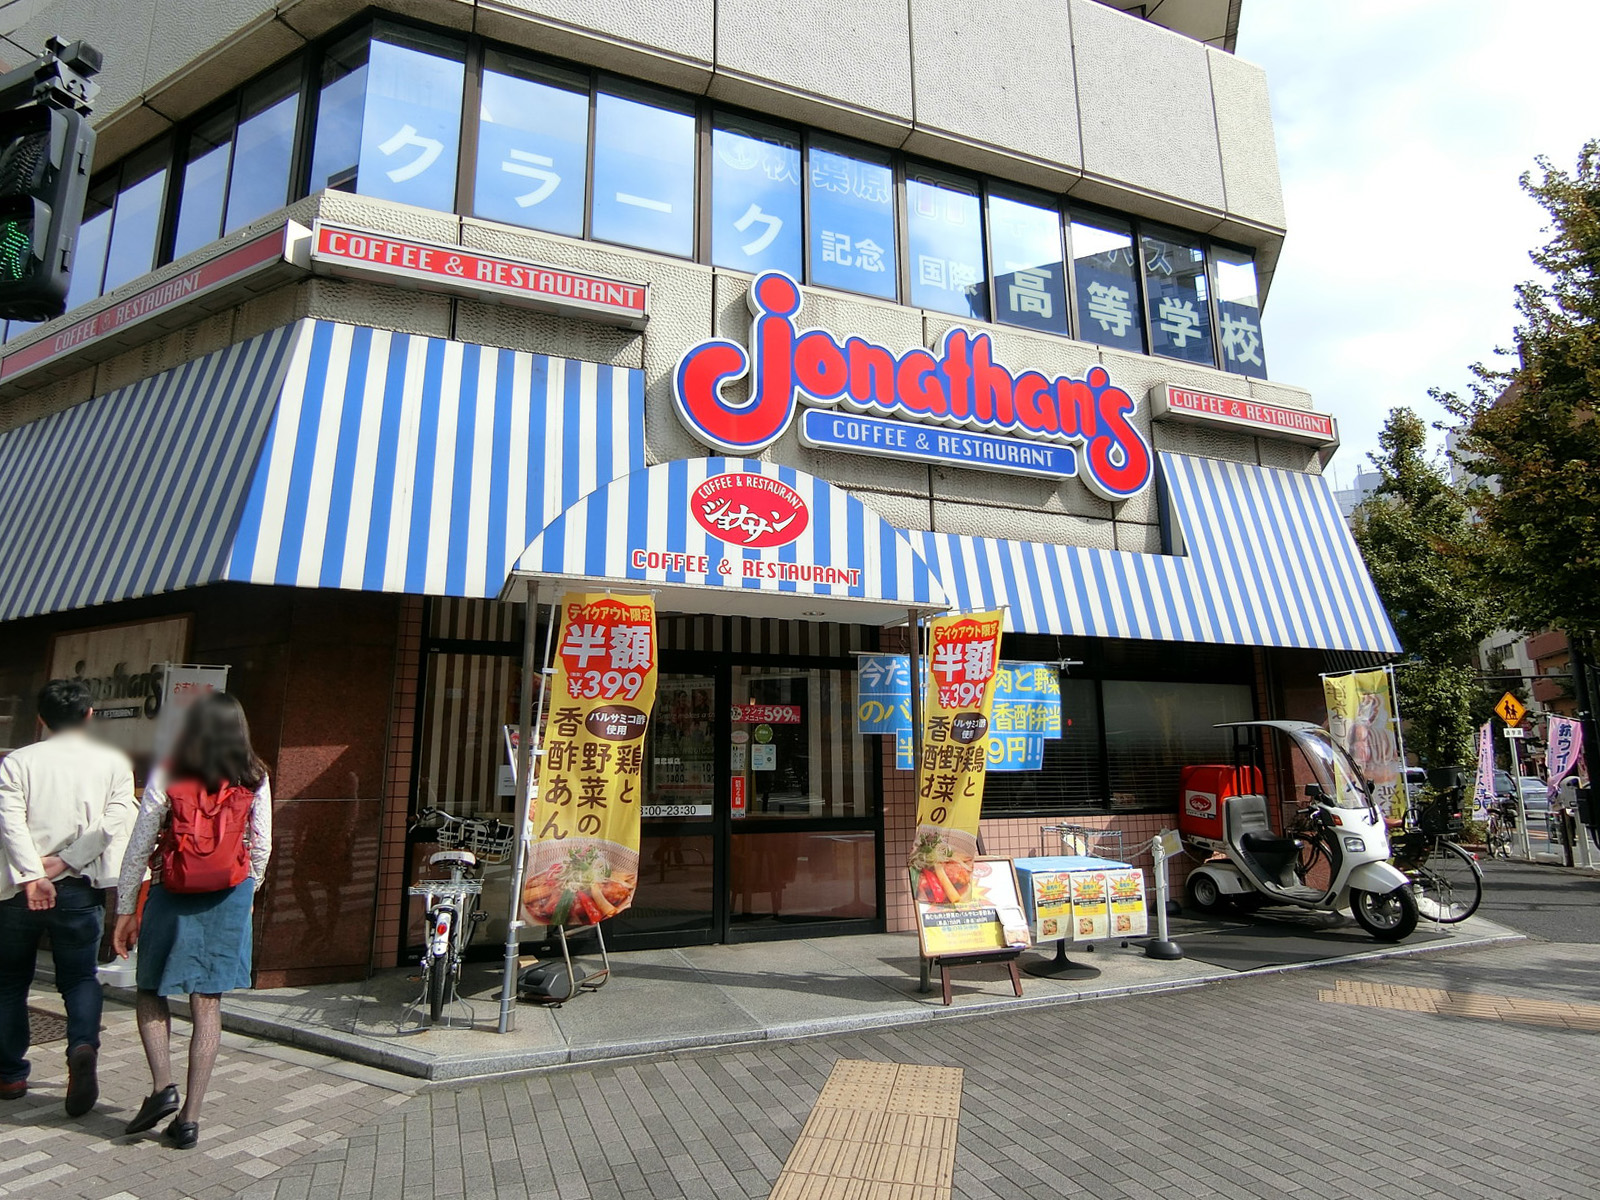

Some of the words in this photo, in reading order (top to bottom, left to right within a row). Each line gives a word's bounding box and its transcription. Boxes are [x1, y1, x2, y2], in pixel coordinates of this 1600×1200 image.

[328, 231, 432, 272] COFFEE
[444, 254, 466, 277] &
[477, 259, 639, 308] RESTAURANT
[54, 318, 97, 352] COFFEE
[115, 270, 202, 325] RESTAURANT
[676, 272, 1152, 498] jonathan's
[1173, 391, 1226, 415] COFFEE
[1230, 402, 1241, 417] &
[1246, 404, 1327, 433] RESTAURANT
[833, 419, 907, 447] COFFEE
[915, 433, 931, 450] &
[938, 437, 1055, 467] RESTAURANT
[698, 475, 734, 500] COFFEE
[735, 476, 743, 487] &
[746, 476, 804, 510] RESTAURANT
[700, 497, 797, 543] ジョナサン
[633, 550, 709, 574] COFFEE
[718, 558, 732, 575] &
[742, 560, 860, 587] RESTAURANT
[570, 606, 651, 622] テイクアウト限定
[936, 622, 998, 641] テイクアウト限定
[562, 624, 651, 670] 半額
[933, 639, 995, 682] 半額
[569, 671, 643, 699] ¥399
[589, 712, 646, 725] バルサミコ酢
[606, 725, 627, 736] 使用
[540, 706, 583, 840] 香酢あん
[577, 742, 612, 835] 野菜の
[614, 744, 642, 804] 鶏と
[961, 745, 984, 798] 鶏と
